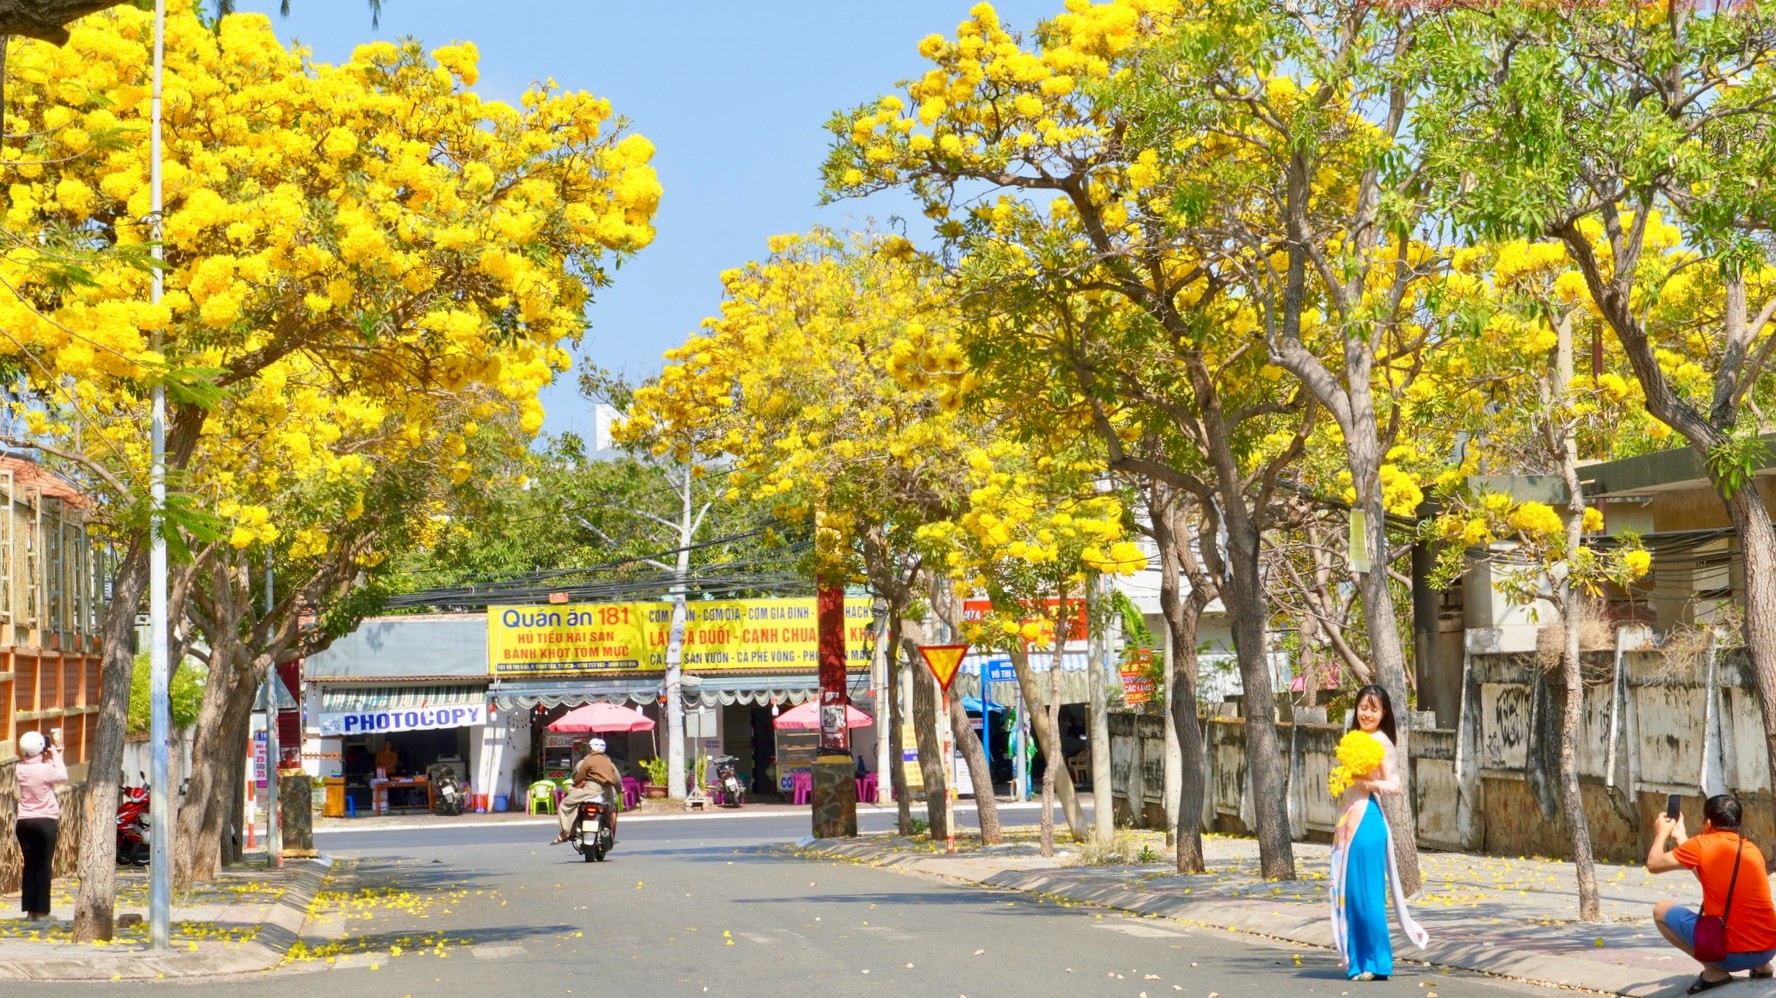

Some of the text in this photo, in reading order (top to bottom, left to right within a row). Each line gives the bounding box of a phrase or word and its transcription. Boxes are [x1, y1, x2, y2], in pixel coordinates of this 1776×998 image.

[503, 607, 629, 628] Quán ăn 181
[770, 607, 785, 620] GIA
[782, 627, 816, 643] CHUA
[344, 707, 480, 732] PHOTOCOPY
